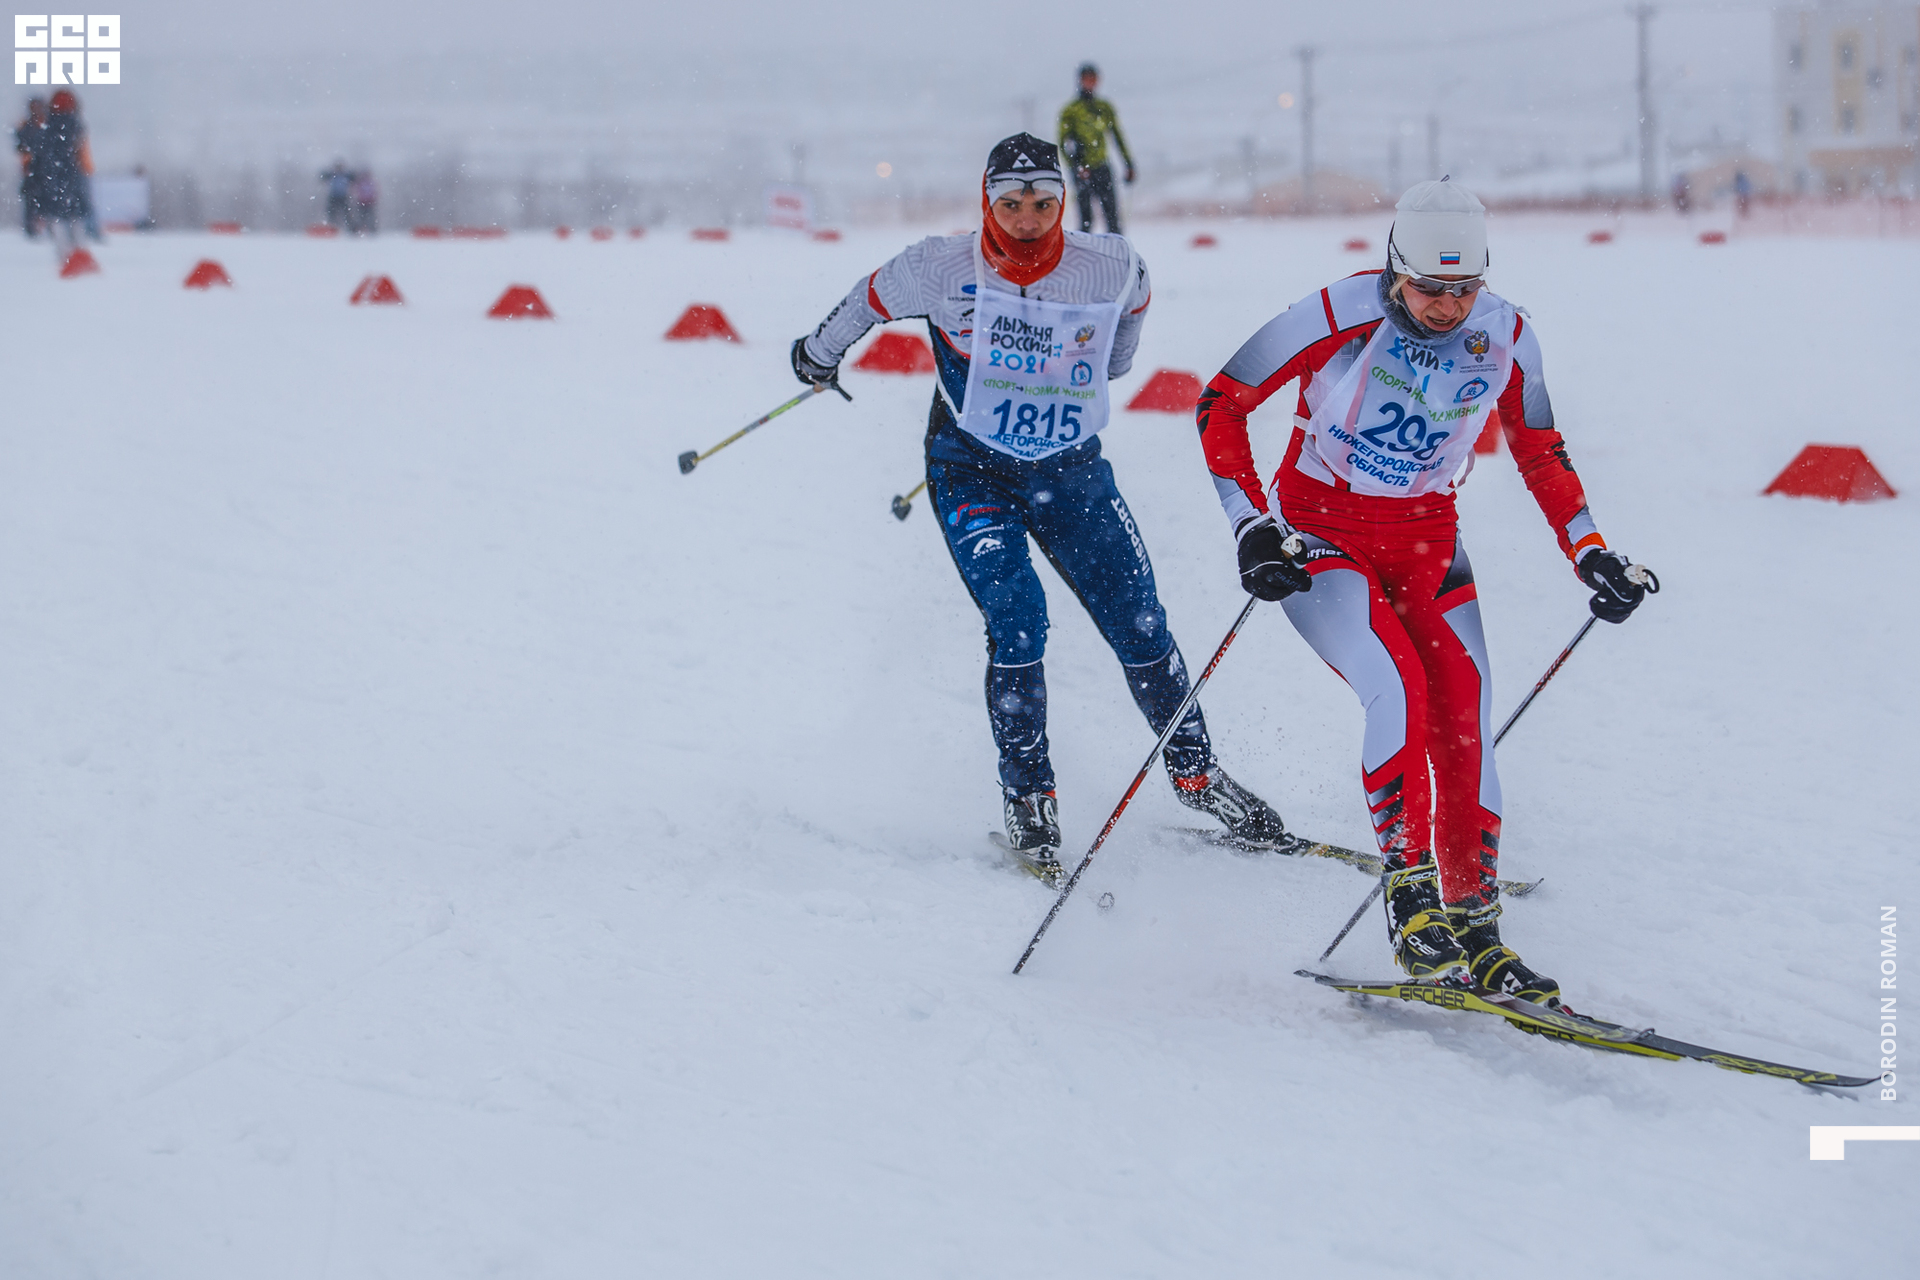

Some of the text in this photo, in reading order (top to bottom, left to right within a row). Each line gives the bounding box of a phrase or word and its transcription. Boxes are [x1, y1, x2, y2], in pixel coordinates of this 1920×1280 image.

[991, 315, 1054, 342] ЛЫЖНЯ
[990, 332, 1053, 358] РОССИИ
[988, 349, 1046, 374] 2021
[983, 378, 1017, 392] СПОРТ
[1024, 385, 1060, 396] НОРМА
[1371, 366, 1481, 422] СПОРТ НОМА ЖИЗНИ
[992, 399, 1083, 443] 1815
[1358, 401, 1450, 461] 298
[1346, 453, 1410, 487] ОБЛАСТЬ
[1111, 497, 1150, 576] INSPORT
[1400, 986, 1466, 1008] FISCHER
